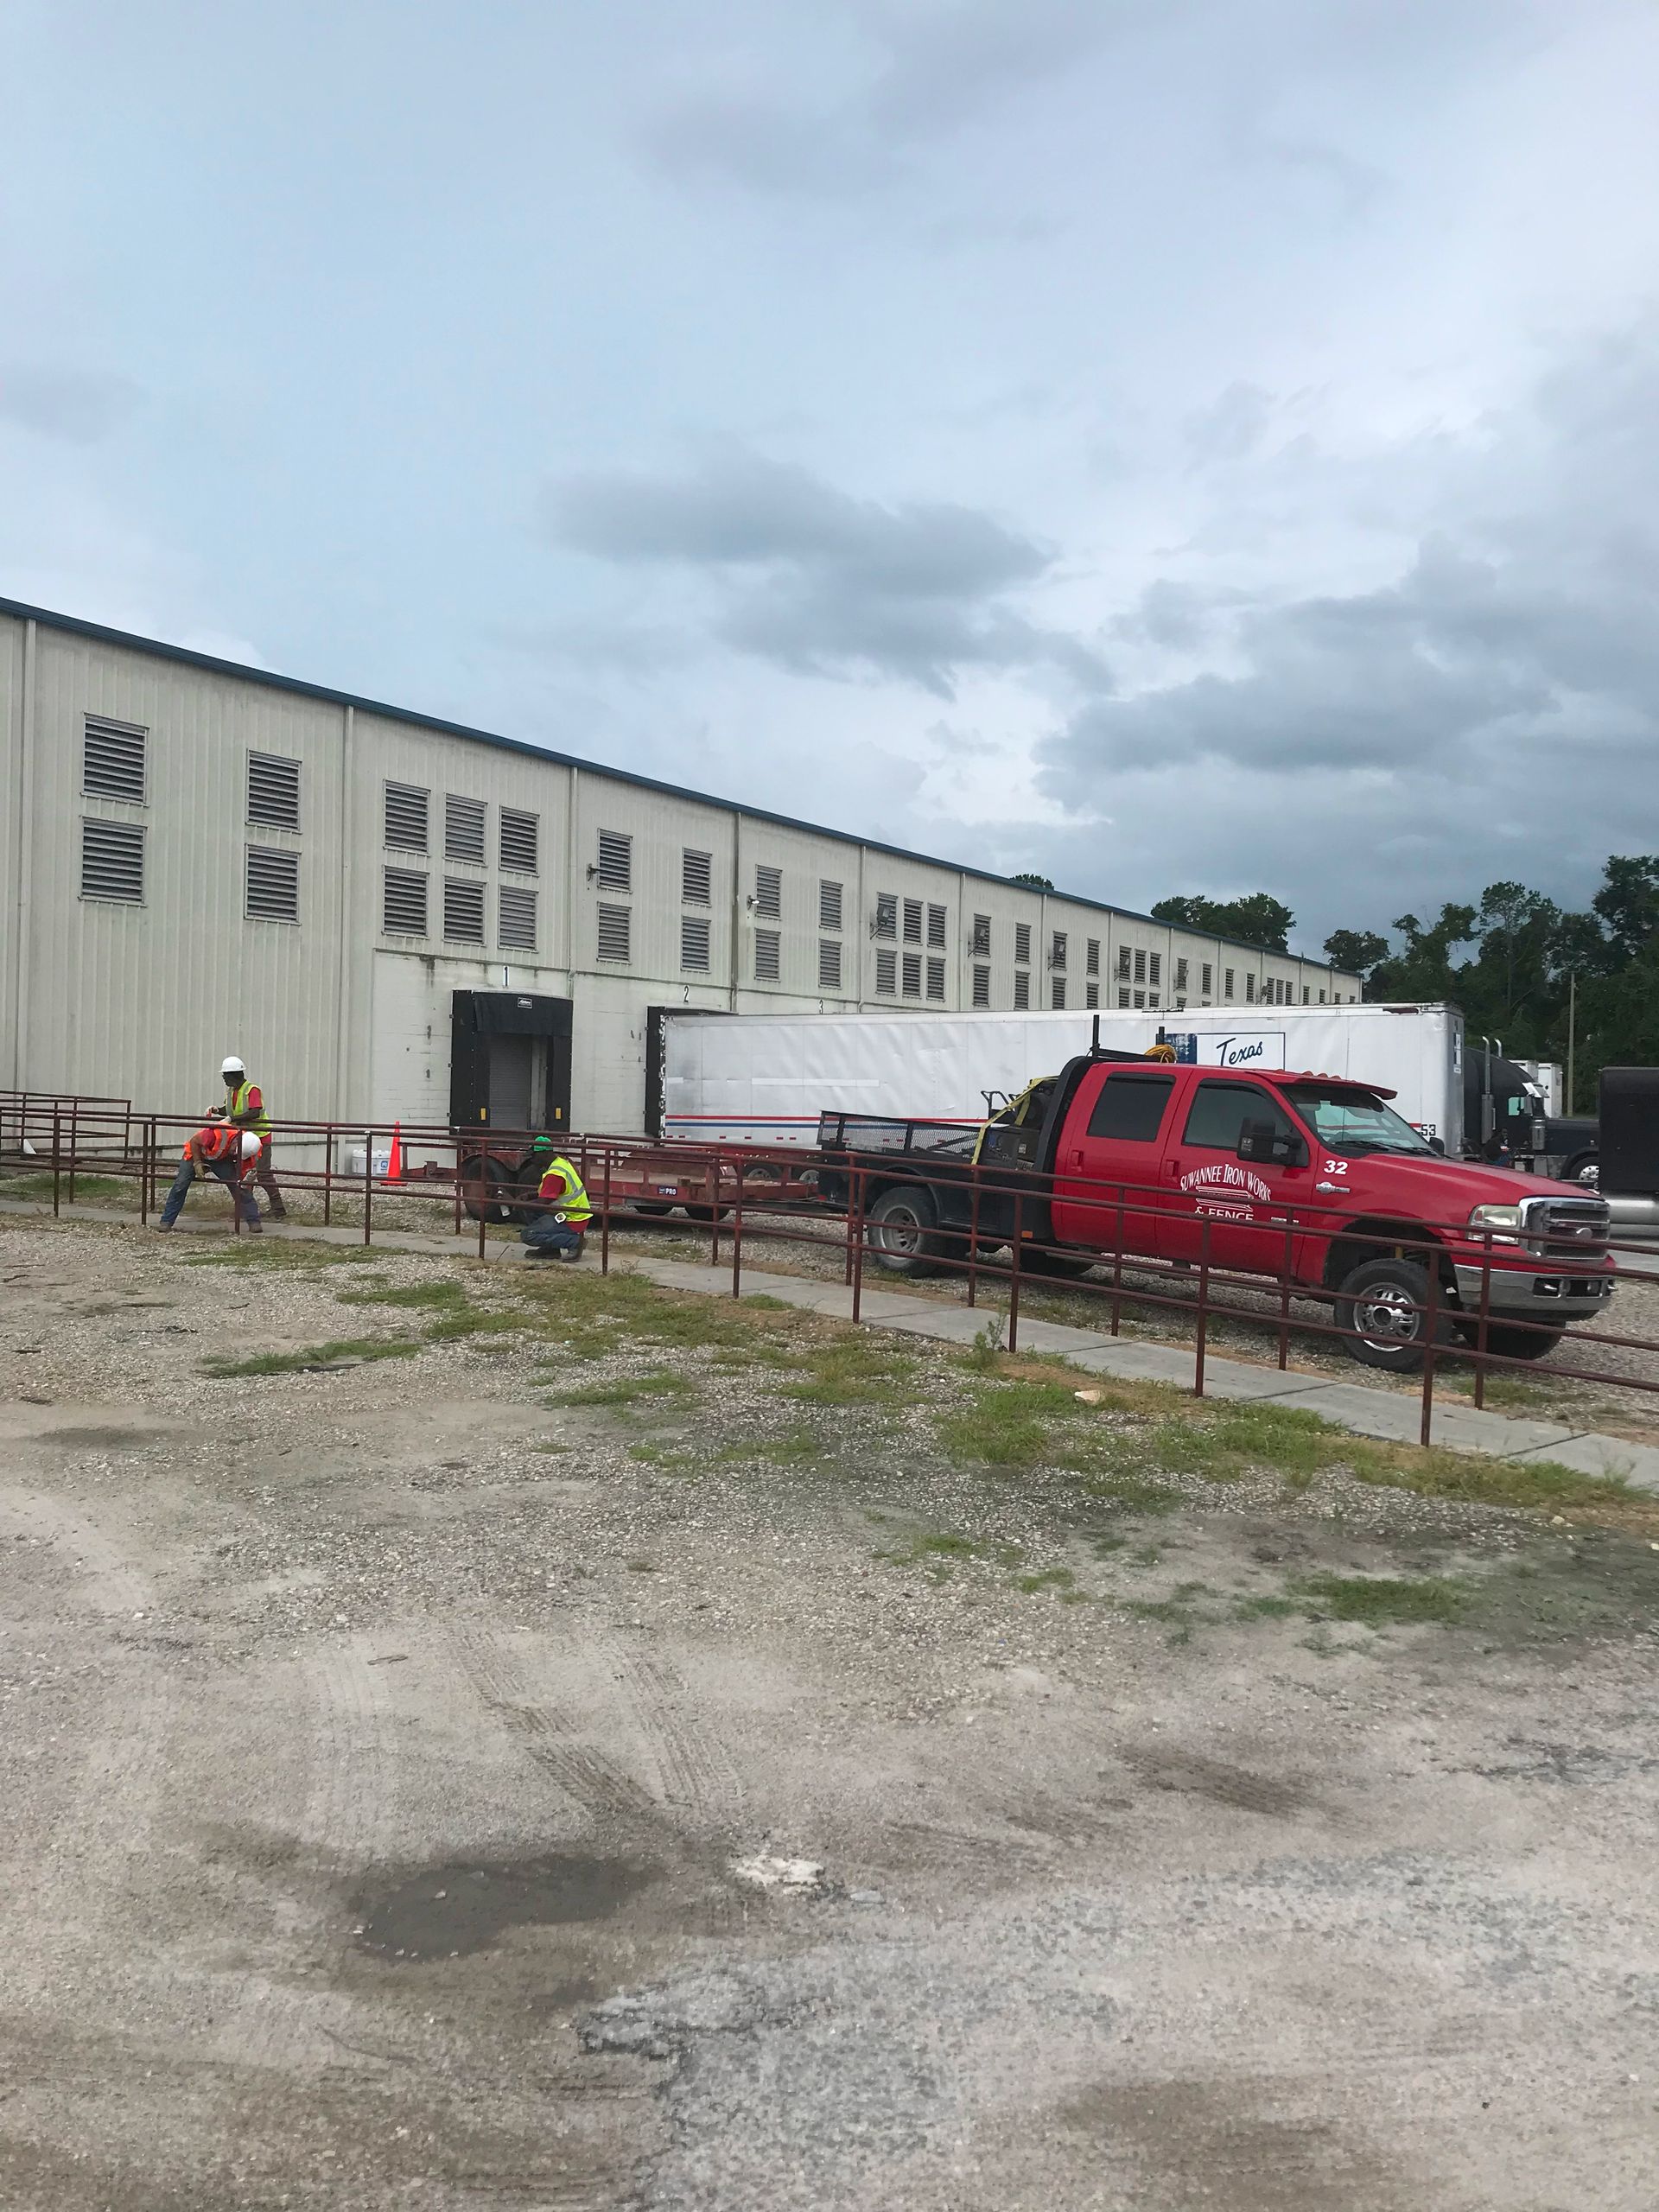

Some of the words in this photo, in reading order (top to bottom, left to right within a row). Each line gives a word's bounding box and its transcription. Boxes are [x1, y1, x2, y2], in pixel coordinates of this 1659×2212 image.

[683, 985, 690, 1002] 2
[1216, 1037, 1263, 1066] Texas
[1421, 1124, 1436, 1136] 53
[1324, 1160, 1348, 1175] 32
[1180, 1166, 1223, 1192] SUWANNEE
[1223, 1163, 1245, 1188] IRON
[1247, 1171, 1272, 1201] WORKS
